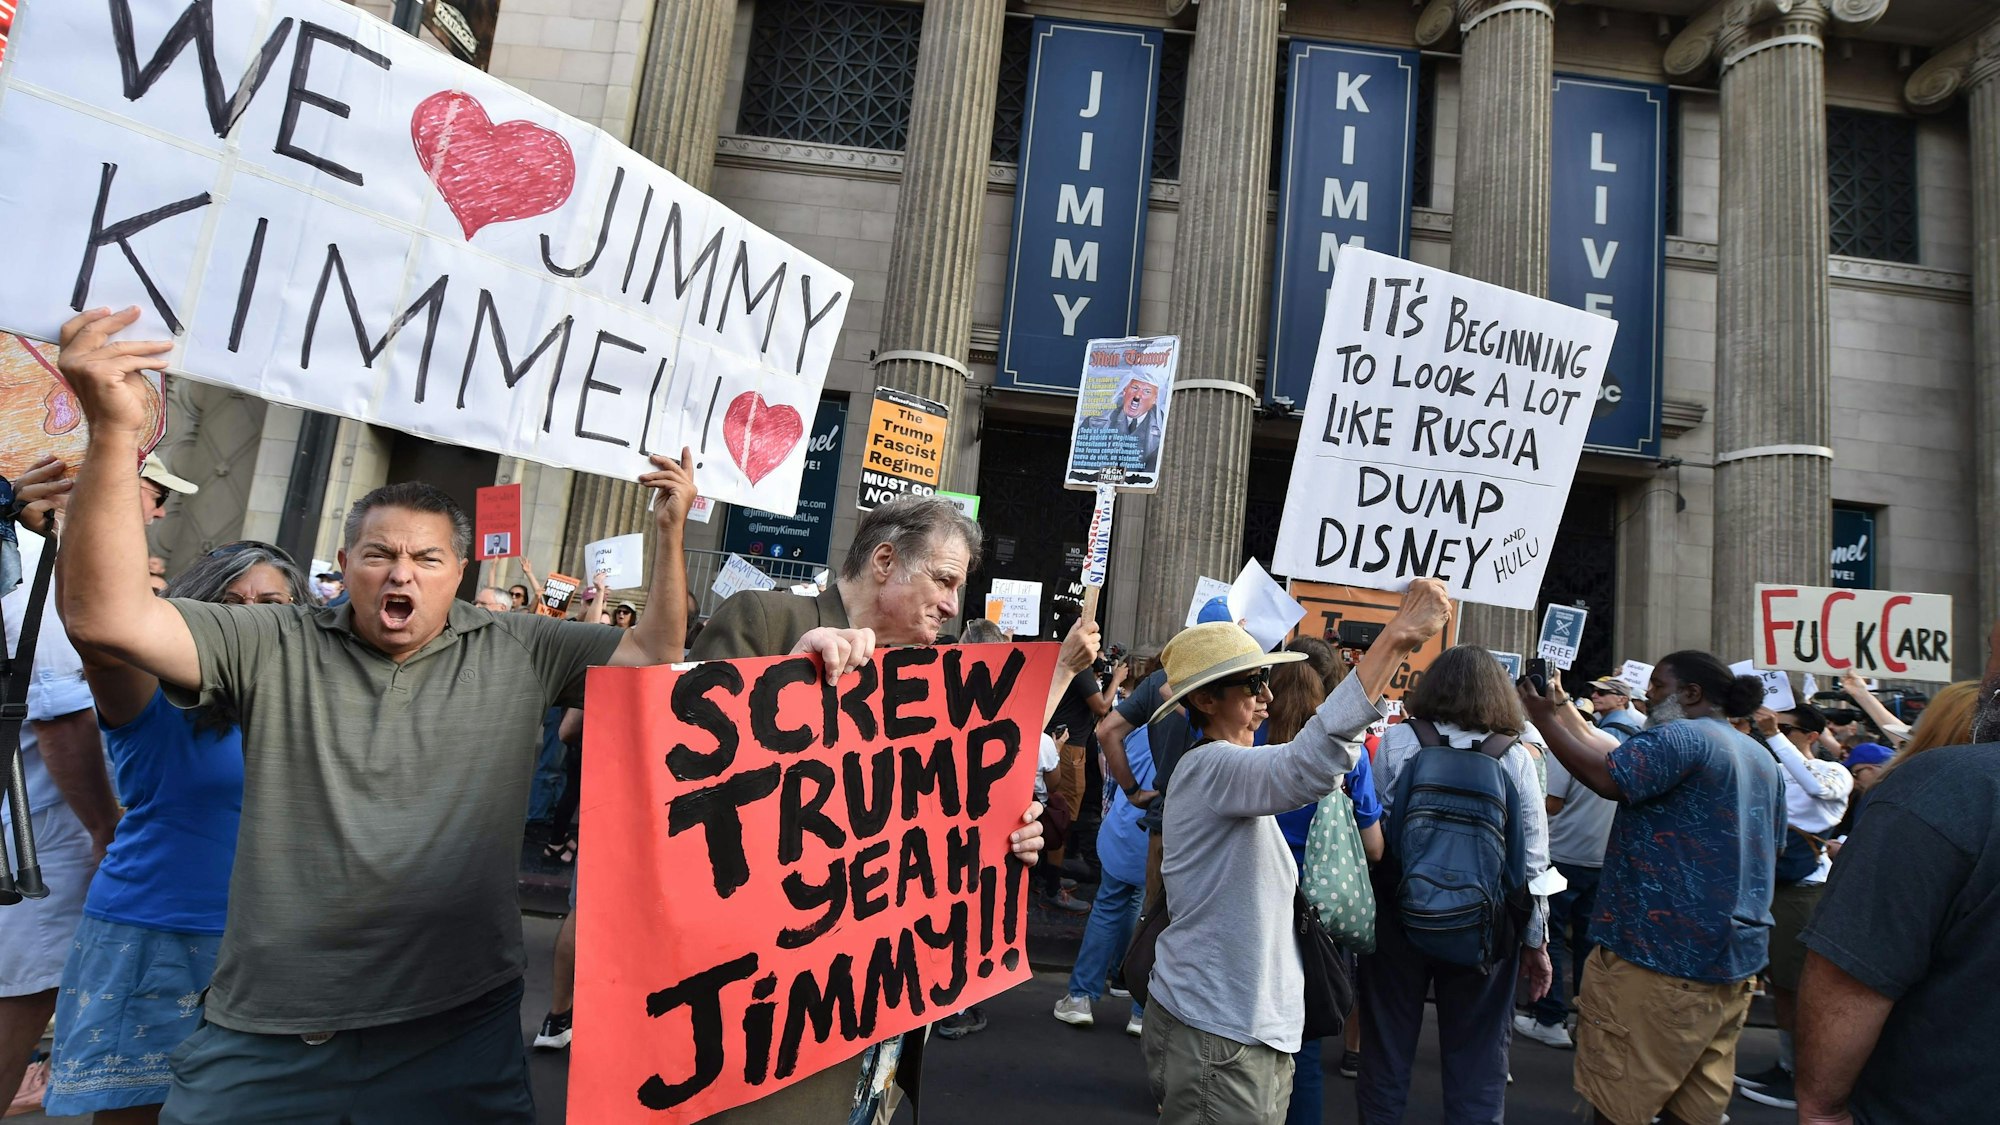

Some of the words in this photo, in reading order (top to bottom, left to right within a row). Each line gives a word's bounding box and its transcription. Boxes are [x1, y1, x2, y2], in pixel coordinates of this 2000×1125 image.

[108, 0, 393, 187] WE
[539, 166, 842, 376] JIMMY
[1318, 71, 1371, 309] KIMM
[1051, 71, 1105, 337] JIMMY
[1444, 295, 1592, 381] BEGINNING
[1336, 344, 1377, 386] TO
[1392, 354, 1475, 397] LOOK
[1484, 372, 1510, 408] A
[1522, 379, 1581, 425] LOT
[1594, 385, 1622, 402] bc
[898, 408, 923, 424] The
[882, 418, 934, 445] Trump
[1322, 393, 1394, 447] LIKE
[1412, 405, 1539, 471] RUSSIA
[873, 433, 937, 462] Fascist
[868, 450, 935, 478] Regime
[863, 472, 908, 492] MUST
[911, 484, 934, 498] GO
[864, 487, 905, 506] NO
[1357, 466, 1504, 530] DUMP
[749, 522, 810, 537] @JimmyKimmel
[1315, 517, 1493, 589] DISNEY
[1503, 527, 1526, 547] AND
[1493, 537, 1540, 584] HULU
[546, 578, 576, 592] TRUMP
[1068, 582, 1083, 595] NO
[1090, 570, 1104, 584] IS
[545, 587, 569, 601] MUST
[547, 599, 560, 609] GO
[1761, 589, 1878, 671] FUCK
[1880, 595, 1951, 673] CARR
[1542, 643, 1573, 659] FREE
[665, 647, 1026, 782] SCREW
[665, 718, 1021, 899] TRUMP
